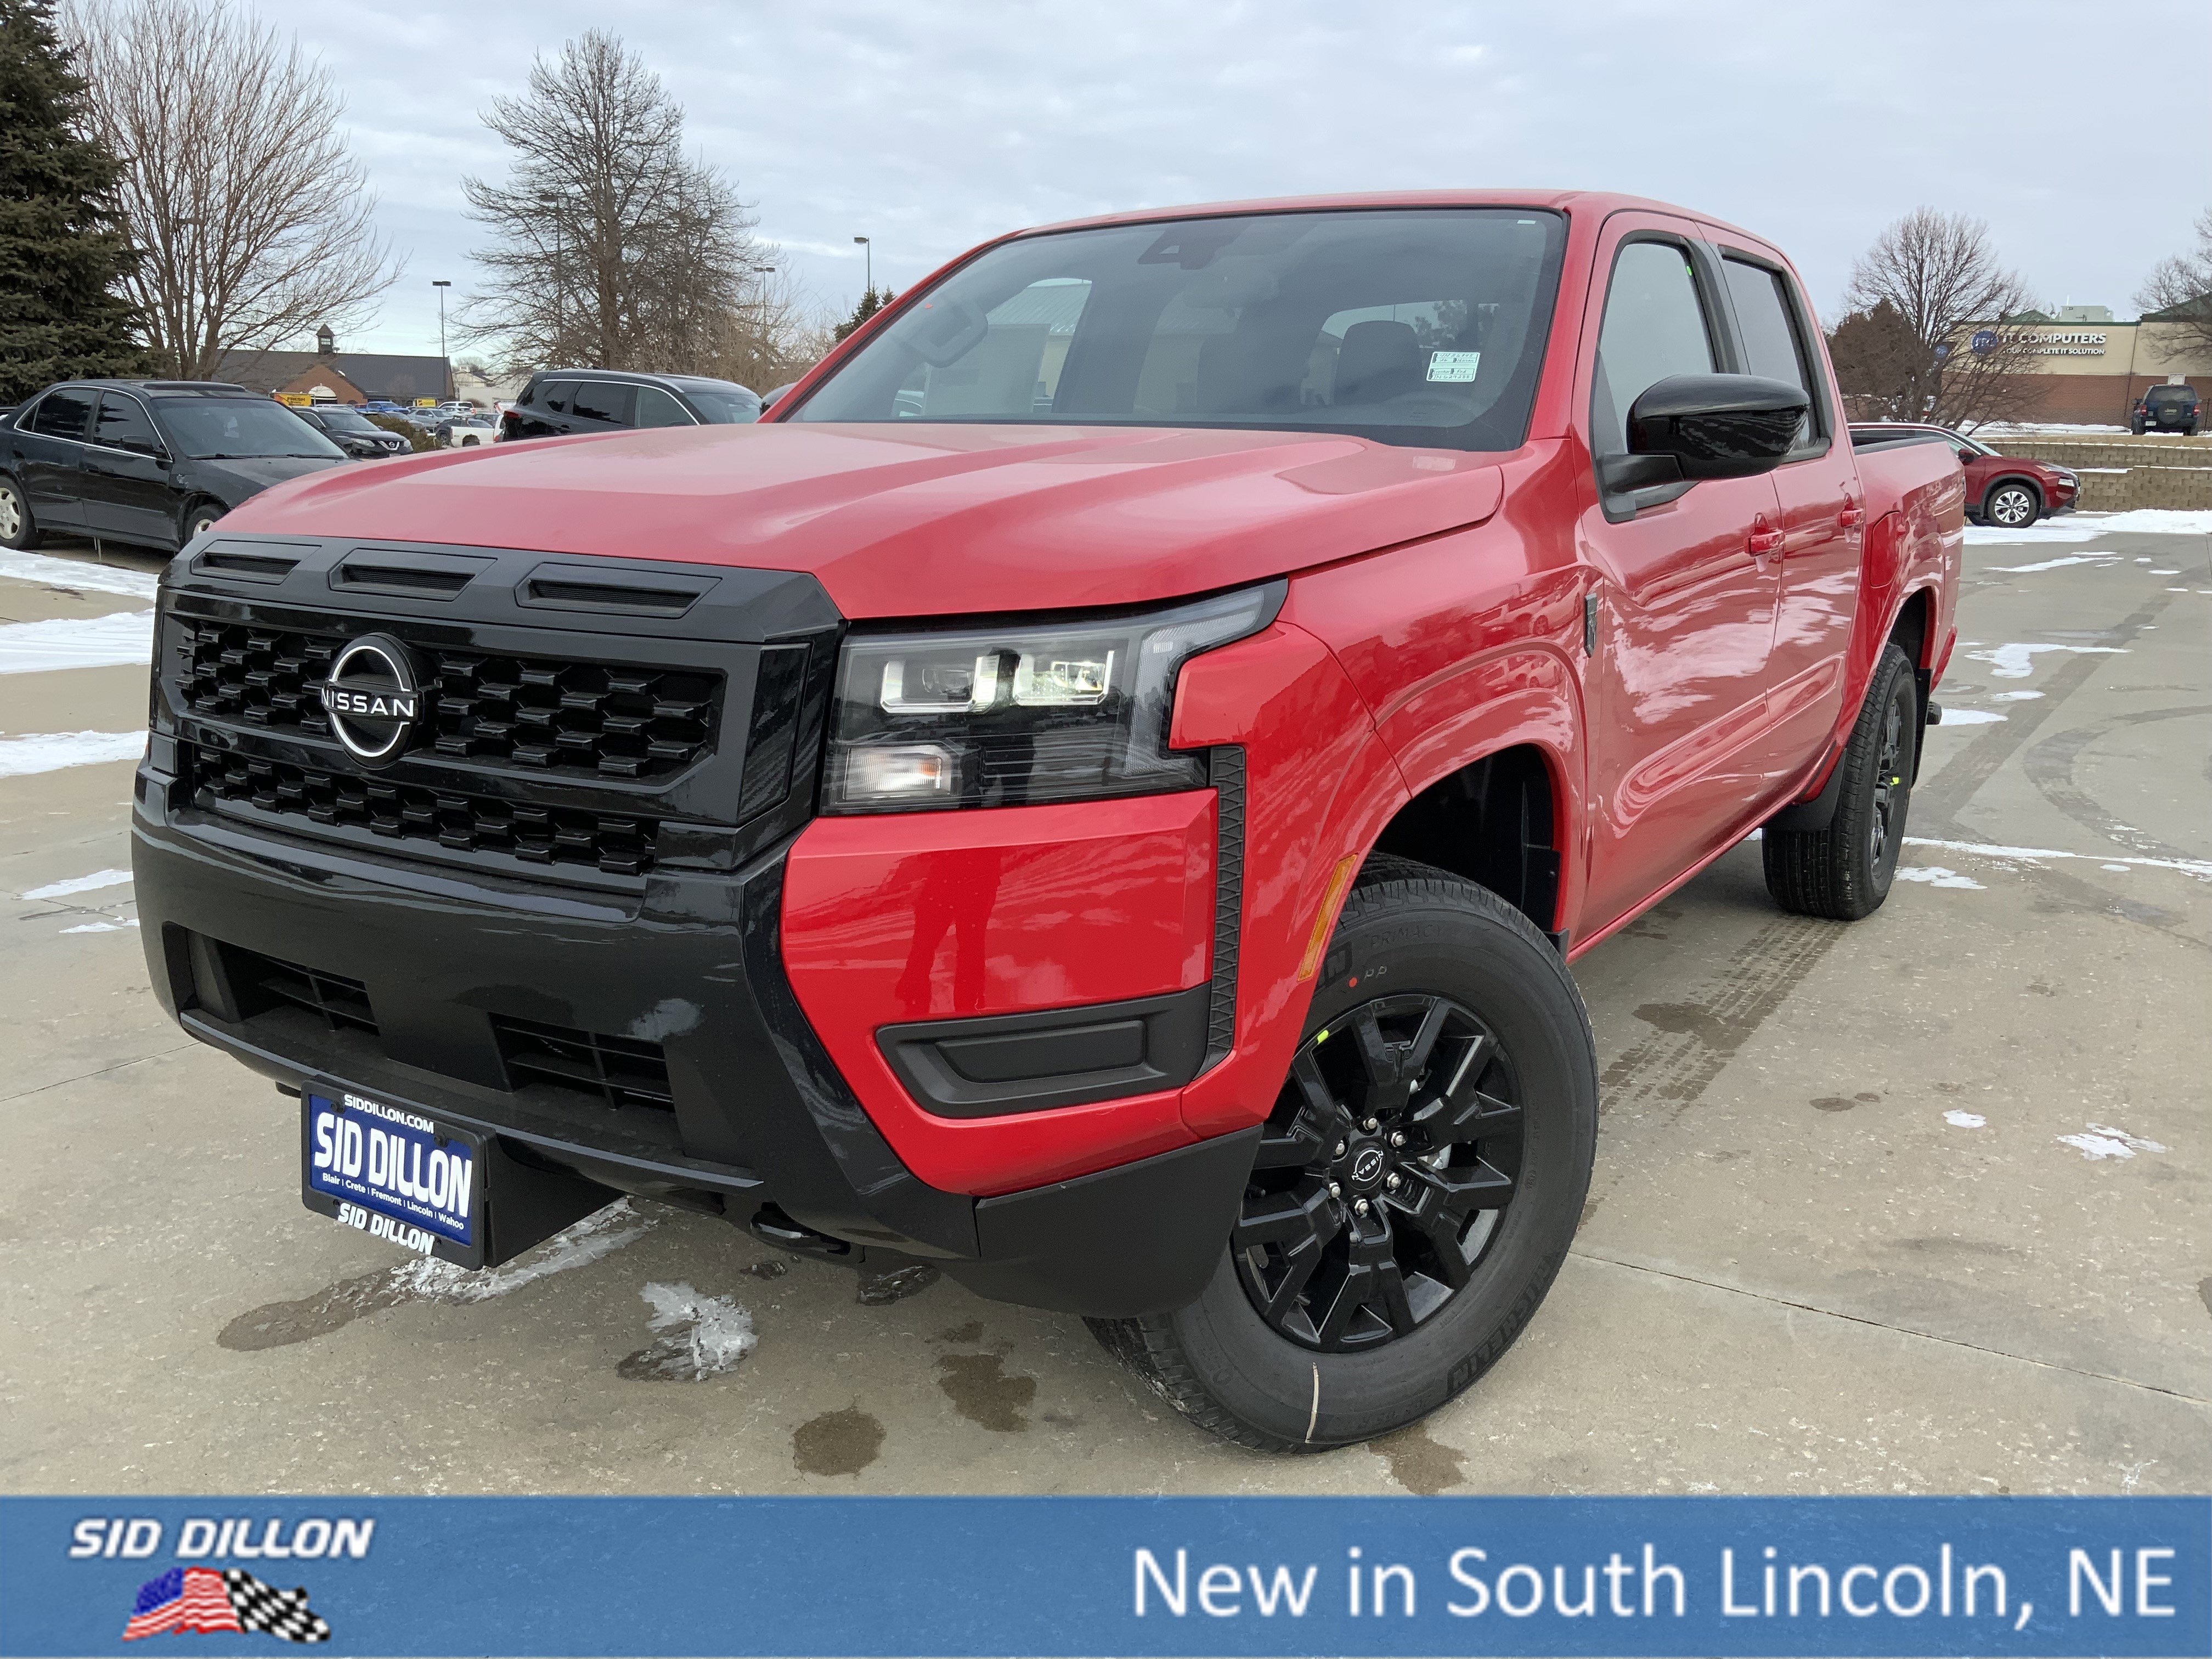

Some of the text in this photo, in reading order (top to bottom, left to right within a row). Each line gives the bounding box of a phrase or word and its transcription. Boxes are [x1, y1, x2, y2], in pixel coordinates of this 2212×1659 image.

[2002, 332, 2016, 343] IT
[2019, 332, 2106, 344] COMPUTERS
[321, 687, 414, 717] NISSAN
[344, 1094, 435, 1135] SIDDILLON.COM
[314, 1111, 473, 1218] SID DILLON
[1351, 1150, 1384, 1181] NISSAN
[323, 1172, 465, 1231] Blair Crete Fremont Lincoln Wahoo
[337, 1202, 435, 1255] SID DILLON
